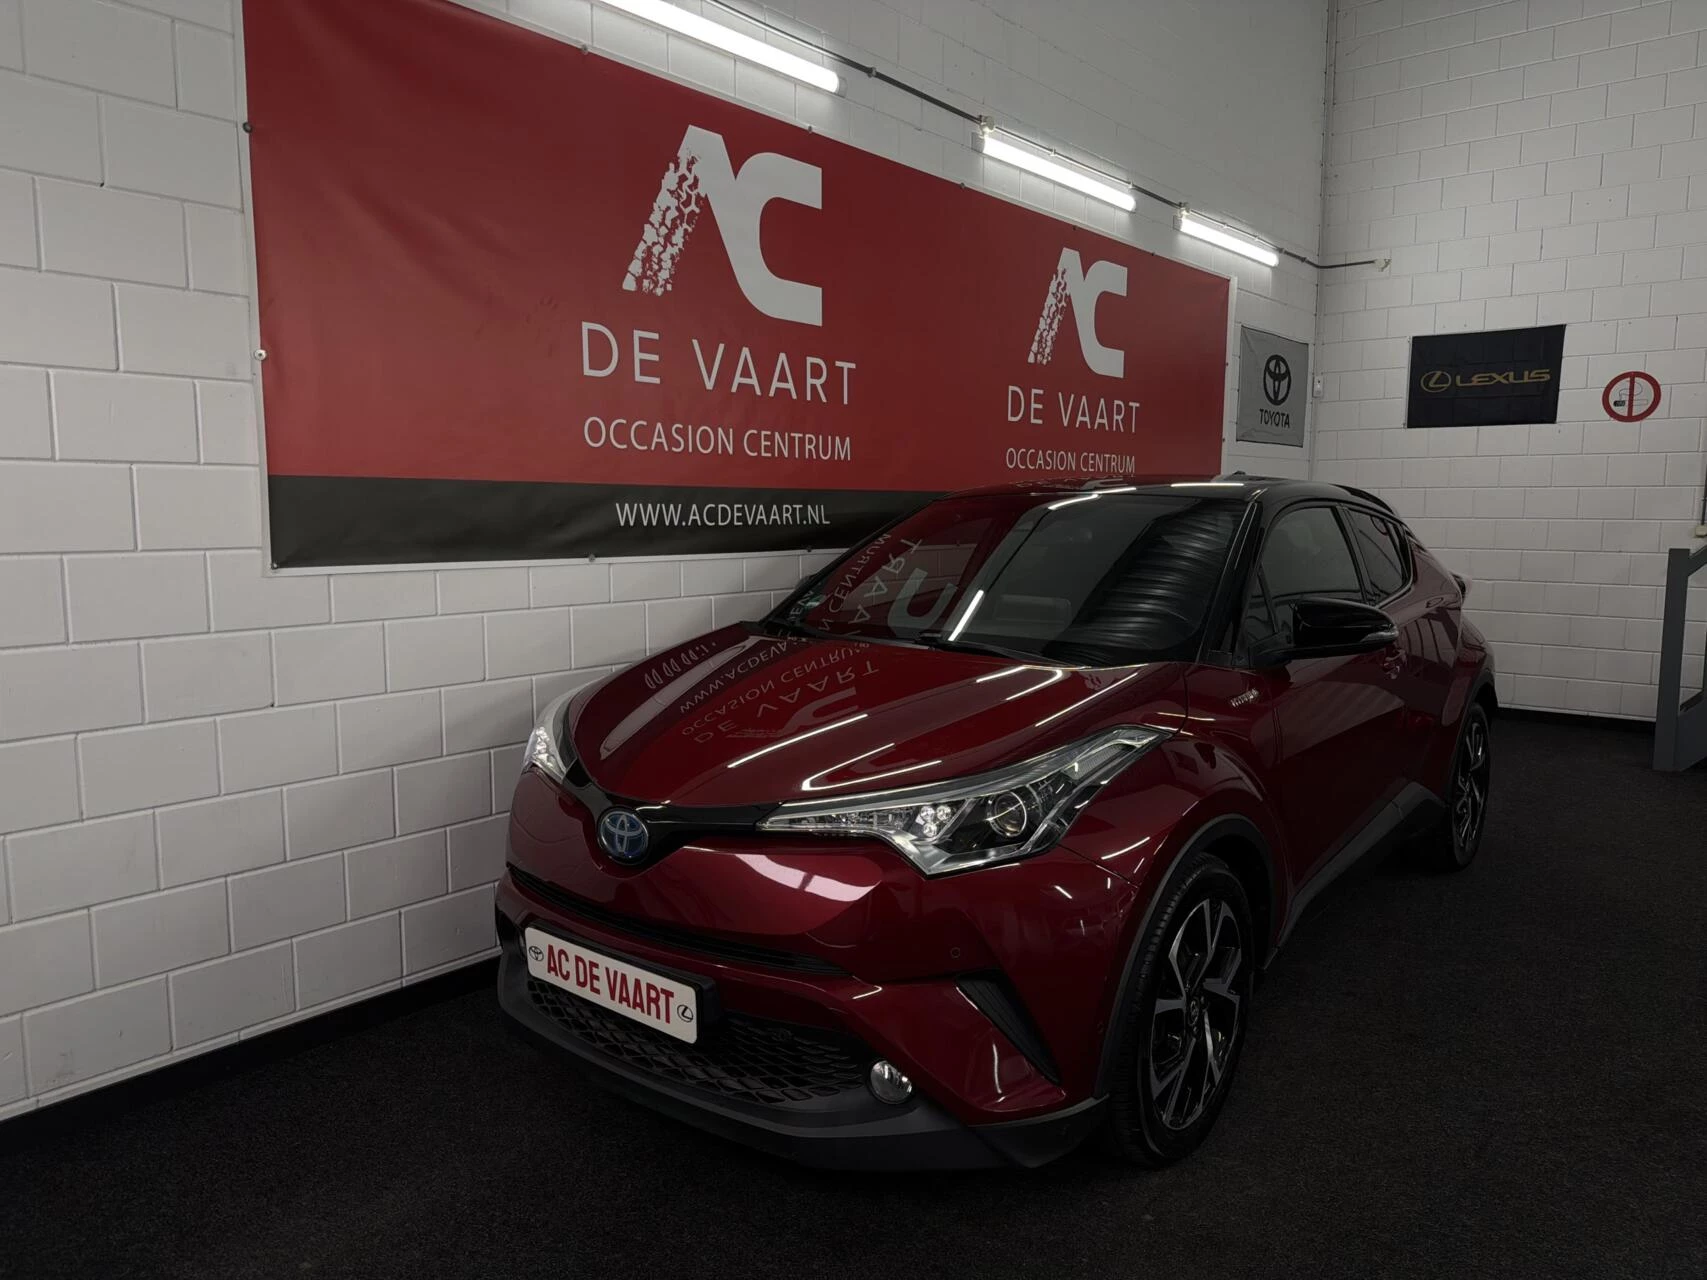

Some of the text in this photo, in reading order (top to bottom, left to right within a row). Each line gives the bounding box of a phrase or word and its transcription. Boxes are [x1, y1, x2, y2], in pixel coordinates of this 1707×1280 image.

[622, 124, 822, 326] AC
[1027, 247, 1128, 378] AC
[581, 320, 857, 405] DE VAART
[1455, 368, 1551, 388] LEXUS
[1007, 385, 1140, 434] DE VAART
[1259, 408, 1291, 429] TOYOTA
[583, 416, 852, 461] OCCASION CENTRUM
[1005, 447, 1136, 474] OCCASION CENTRUM
[615, 502, 831, 528] WWW.ACDEVAART.NL
[547, 944, 675, 1024] AC DE VAART
